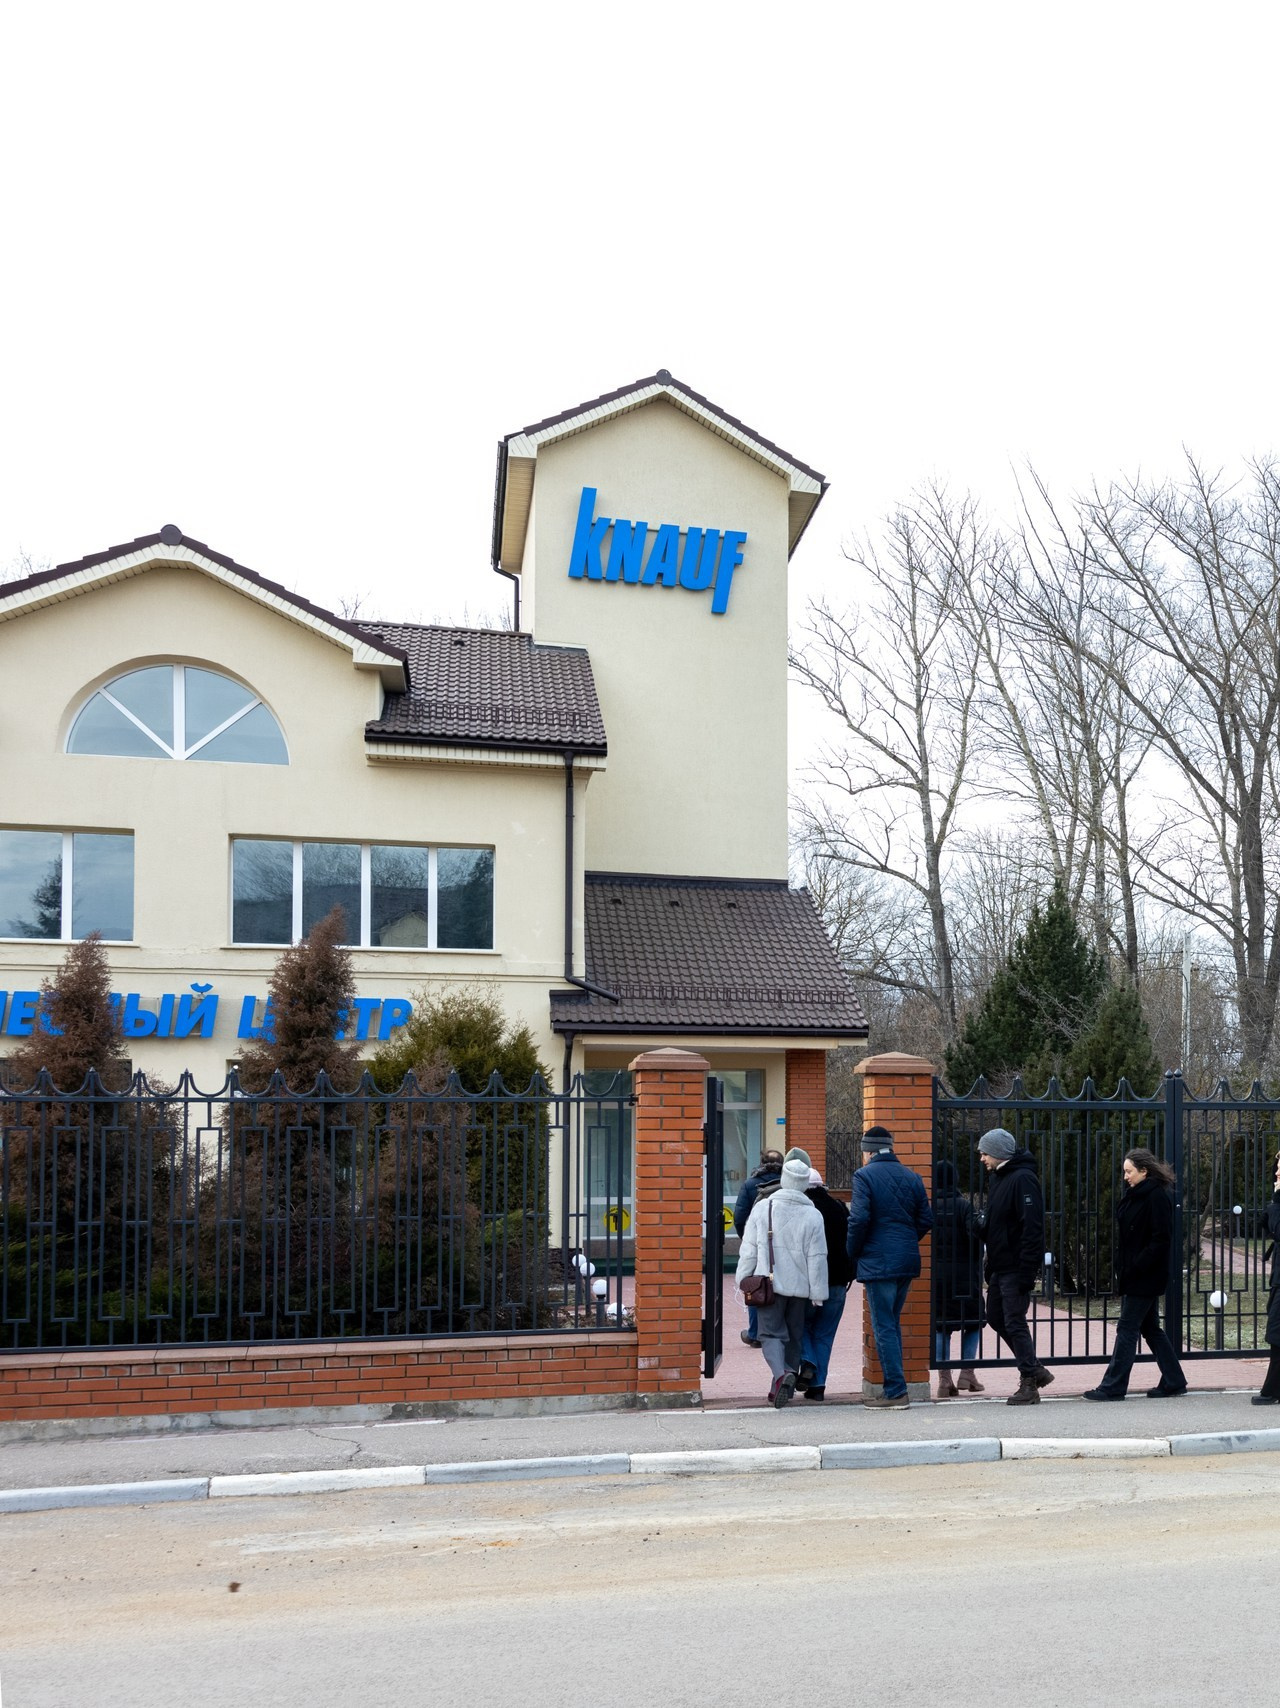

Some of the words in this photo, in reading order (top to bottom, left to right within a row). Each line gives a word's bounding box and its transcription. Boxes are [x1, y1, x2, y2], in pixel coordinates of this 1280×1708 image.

[568, 487, 748, 614] KNAUF
[0, 983, 219, 1039] ЕЫЙ
[237, 996, 413, 1044] ЦТР
